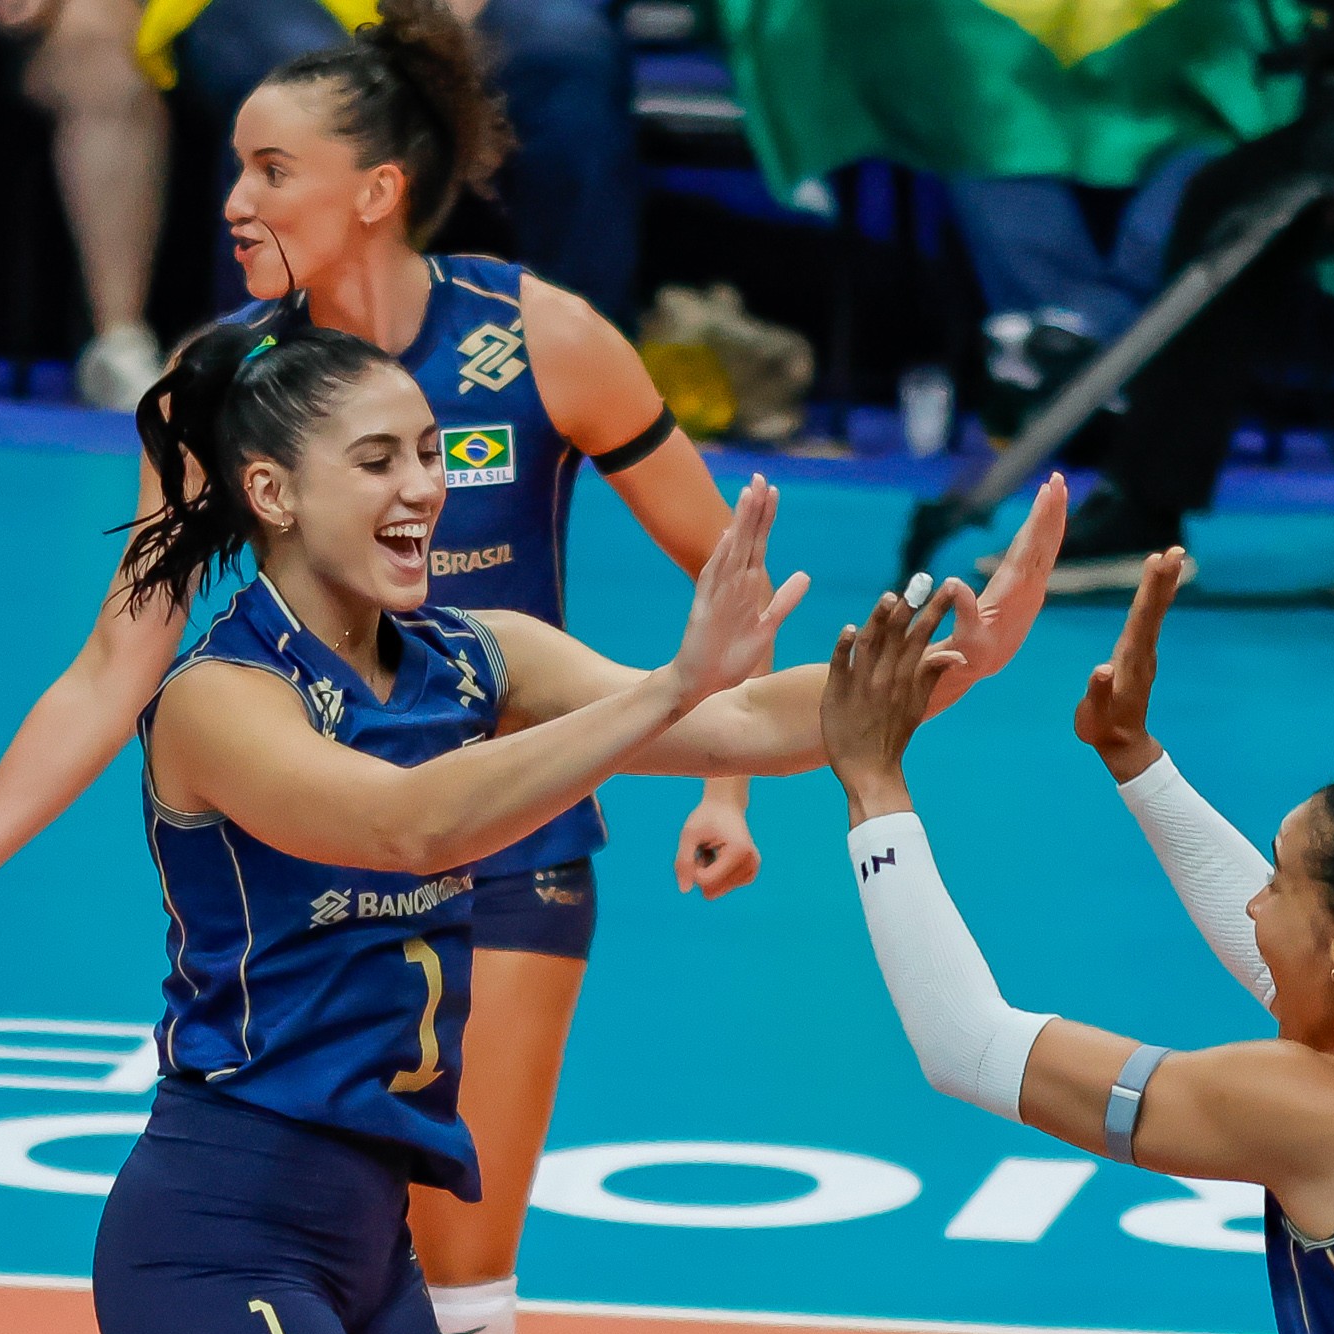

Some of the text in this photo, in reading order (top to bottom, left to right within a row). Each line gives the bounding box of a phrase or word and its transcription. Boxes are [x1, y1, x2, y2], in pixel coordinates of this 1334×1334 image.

[446, 470, 512, 486] BRASIL
[430, 544, 514, 577] BRASIL
[387, 937, 444, 1092] 1
